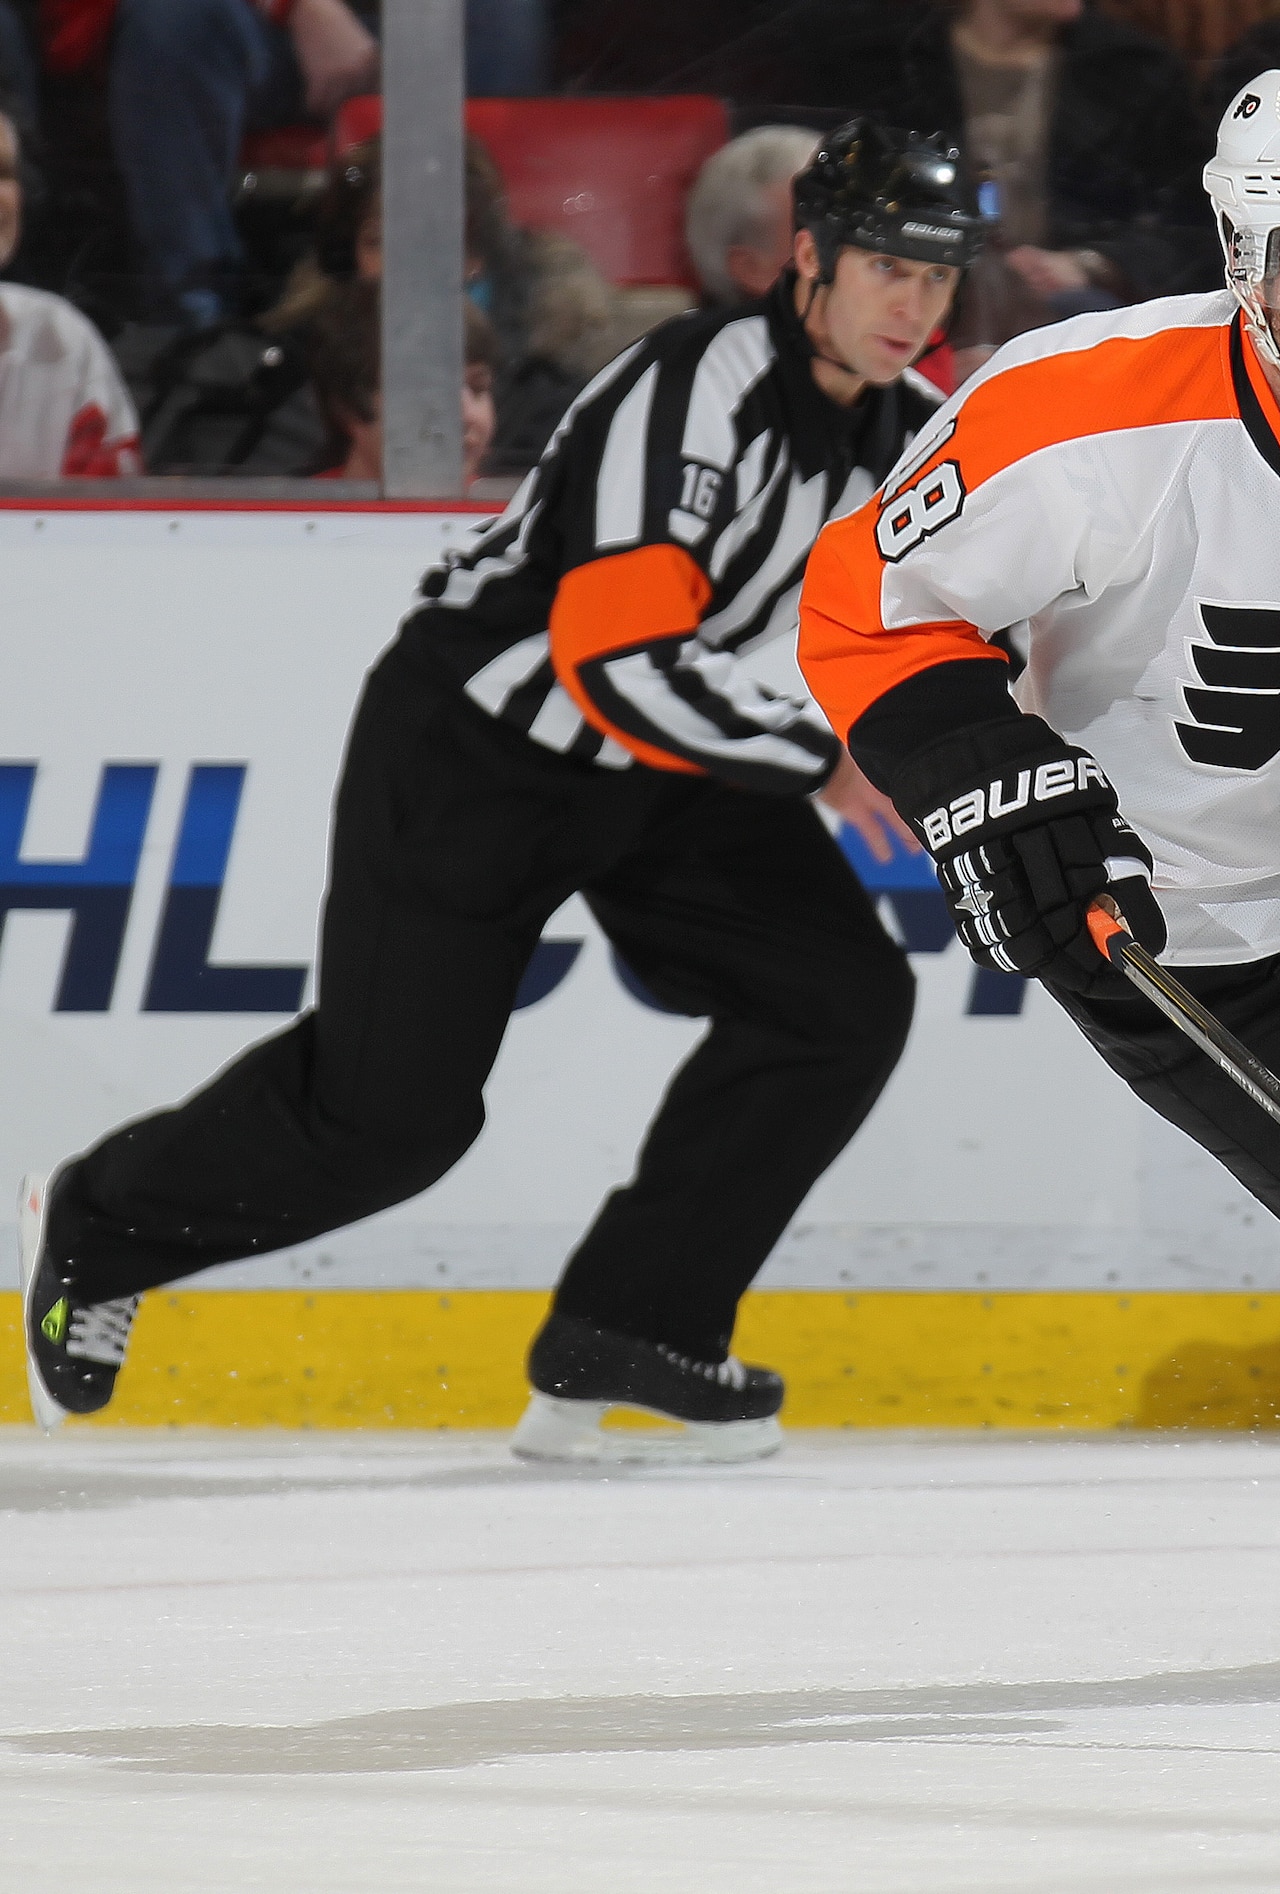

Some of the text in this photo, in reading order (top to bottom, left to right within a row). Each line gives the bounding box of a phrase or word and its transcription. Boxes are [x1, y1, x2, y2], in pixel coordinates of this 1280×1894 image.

[902, 221, 961, 241] BAUER
[681, 462, 722, 517] 16
[924, 757, 1110, 852] BAUER
